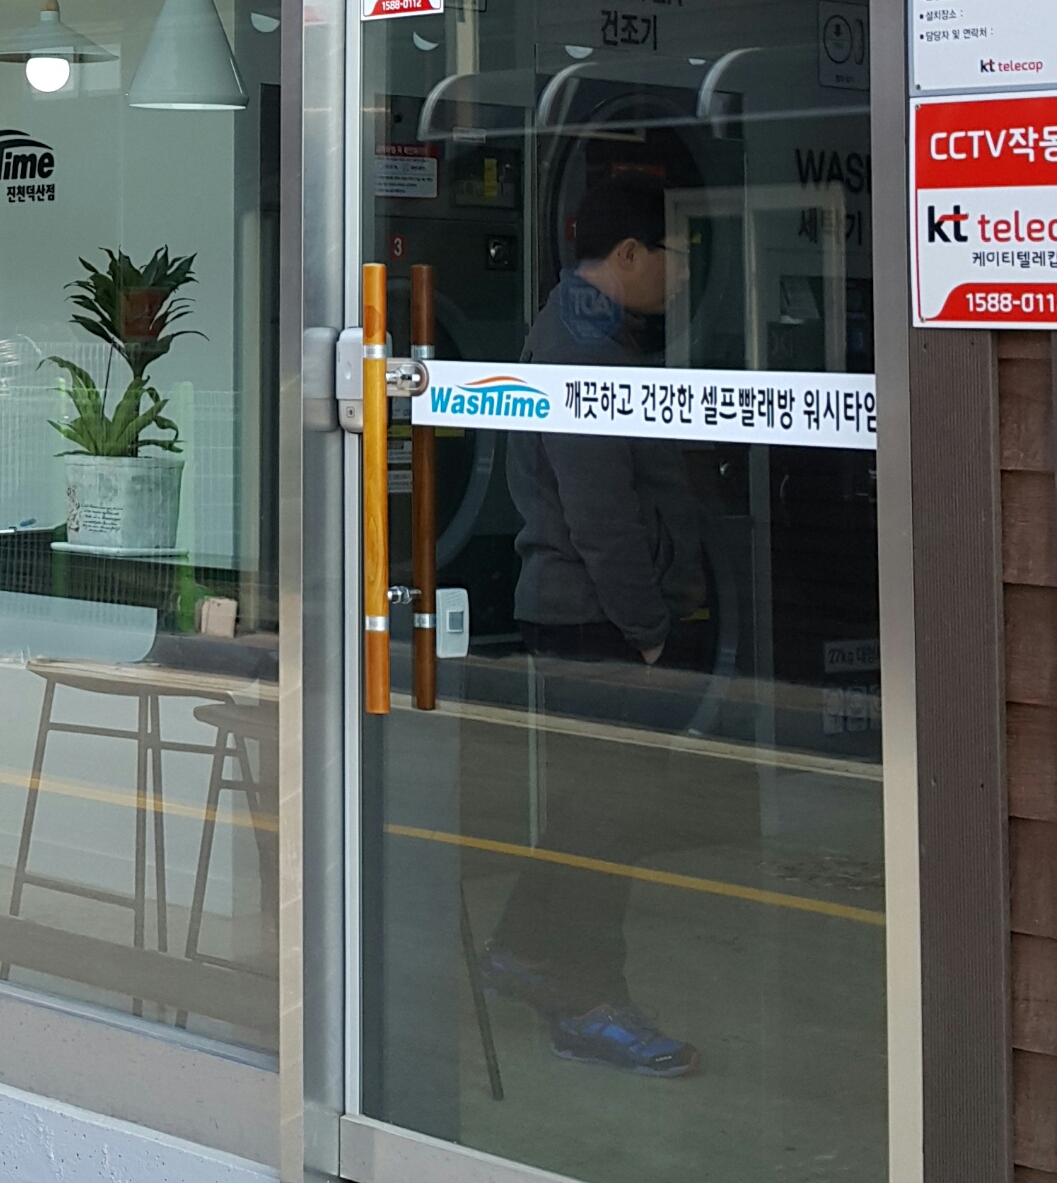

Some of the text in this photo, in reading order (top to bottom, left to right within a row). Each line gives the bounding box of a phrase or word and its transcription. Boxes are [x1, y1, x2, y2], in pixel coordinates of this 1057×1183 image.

[925, 9, 957, 21] 설치장소
[601, 9, 658, 51] 건조기
[926, 27, 987, 42] 담당자 및 연락처
[980, 59, 1043, 73] kt telecop
[795, 149, 871, 194] WAS
[7, 183, 55, 203] 진천덕산점
[928, 205, 969, 243] kt
[394, 238, 402, 256] 3
[430, 384, 550, 420] WashTime
[564, 380, 634, 422] 깨끗하고
[641, 384, 694, 425] 건강한
[700, 387, 795, 430] 셀프빨래방
